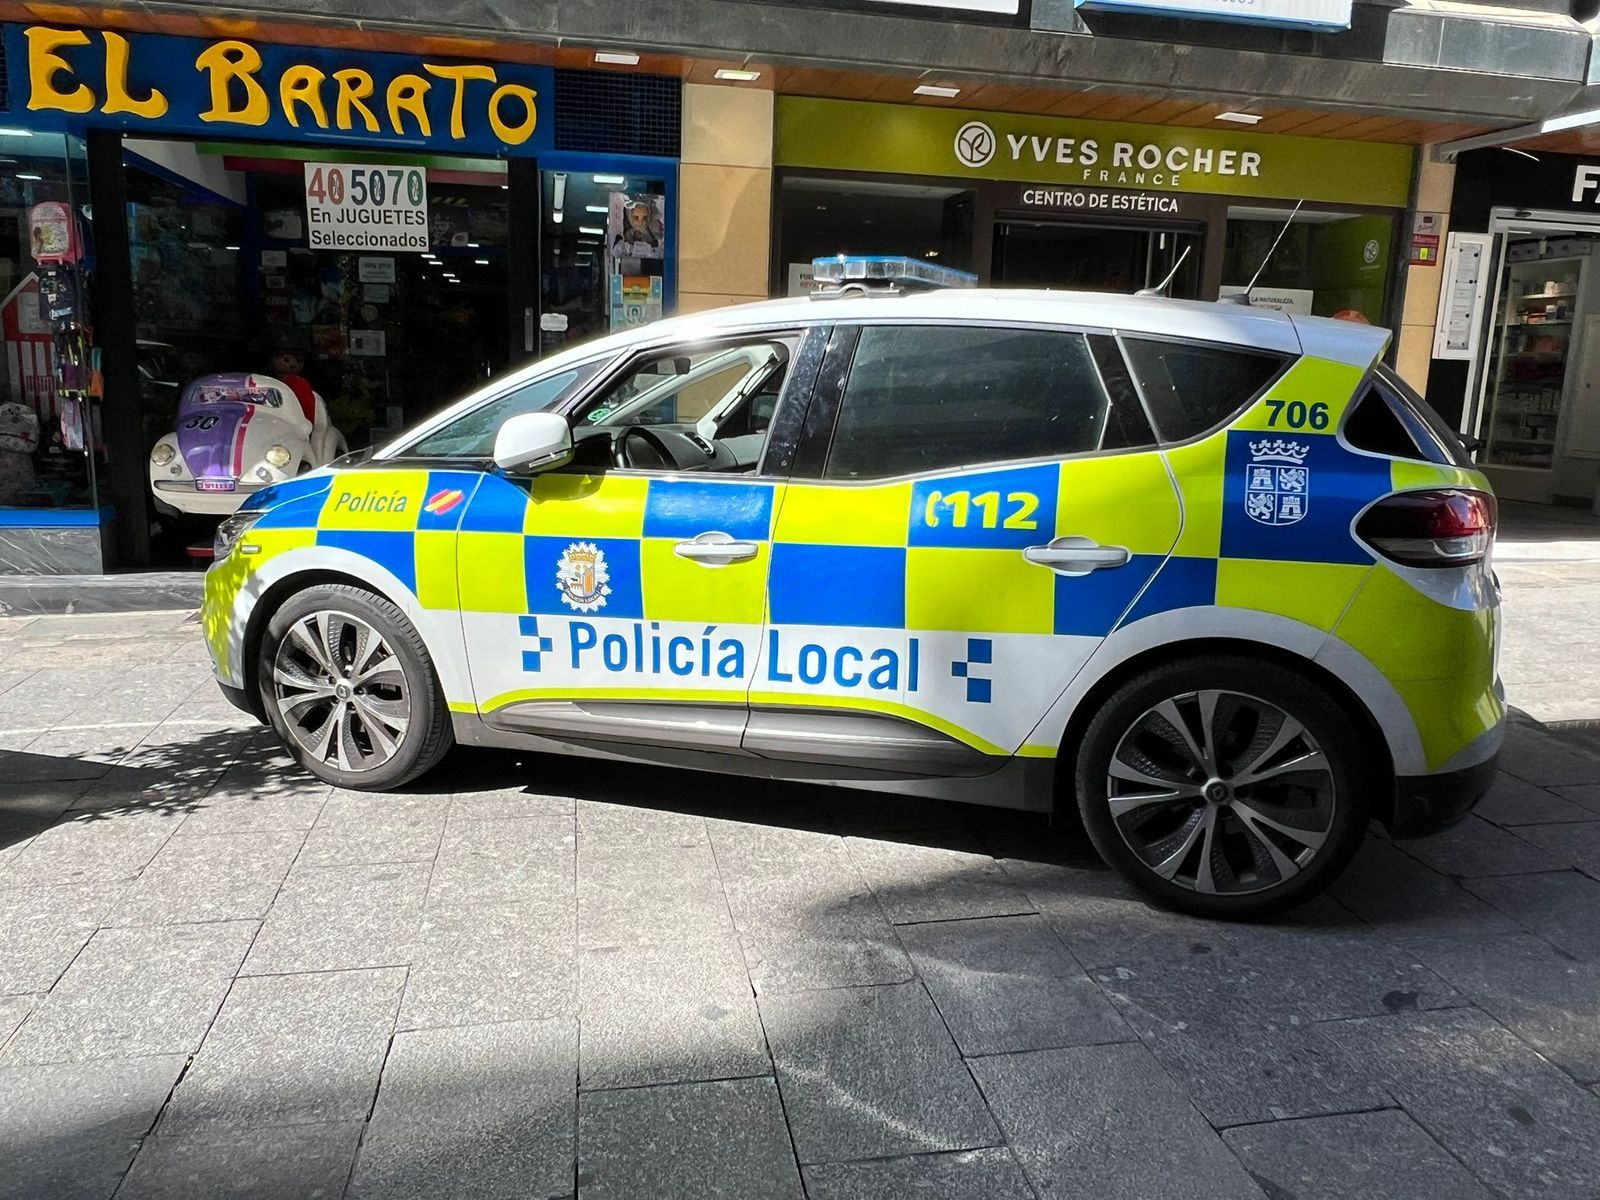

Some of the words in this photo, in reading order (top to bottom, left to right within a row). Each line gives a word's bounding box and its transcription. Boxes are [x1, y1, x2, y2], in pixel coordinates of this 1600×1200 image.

[24, 26, 168, 119] EL
[1006, 133, 1099, 166] YVES
[1112, 142, 1262, 177] ROCHER
[1083, 168, 1181, 187] FRANCE
[1571, 164, 1600, 203] F
[310, 207, 331, 223] En
[336, 208, 425, 225] JUGUETES
[1023, 189, 1085, 208] CENTRO
[1089, 193, 1108, 209] DE
[1112, 192, 1178, 213] ESTÉTICA
[311, 230, 427, 247] Seleccionados
[1265, 400, 1329, 430] 706
[334, 489, 408, 513] Policía
[942, 490, 1040, 530] 112
[568, 621, 745, 679] Policía
[767, 629, 919, 692] Local
